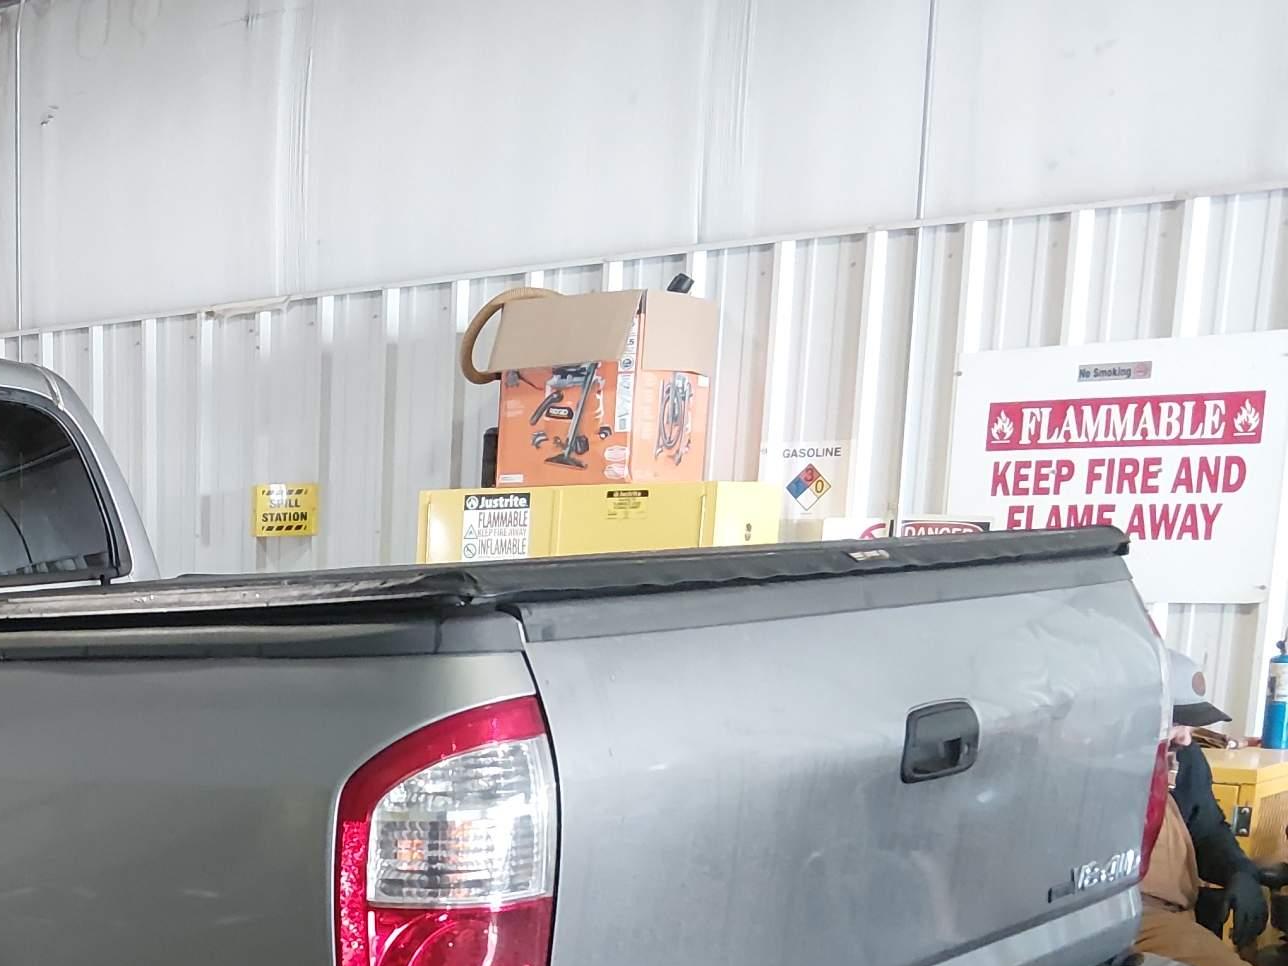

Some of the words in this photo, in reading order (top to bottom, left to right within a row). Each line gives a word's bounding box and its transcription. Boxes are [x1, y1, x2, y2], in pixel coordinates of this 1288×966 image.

[1079, 368, 1091, 378] No
[1093, 366, 1132, 378] Smoking
[1019, 400, 1226, 444] FLAMMABLE
[782, 447, 842, 458] GASOLINE
[990, 459, 1075, 496] KEEP
[1085, 457, 1162, 495] FIRE
[1170, 455, 1247, 494] AND
[815, 479, 824, 493] 0
[478, 494, 529, 509] Justrite
[261, 511, 308, 522] STATION
[478, 510, 529, 528] FLAMMABLE
[1006, 503, 1116, 532] FLAME
[1126, 503, 1223, 540] AWAY
[904, 526, 974, 537] DAN
[478, 538, 527, 554] INFLAMABLE
